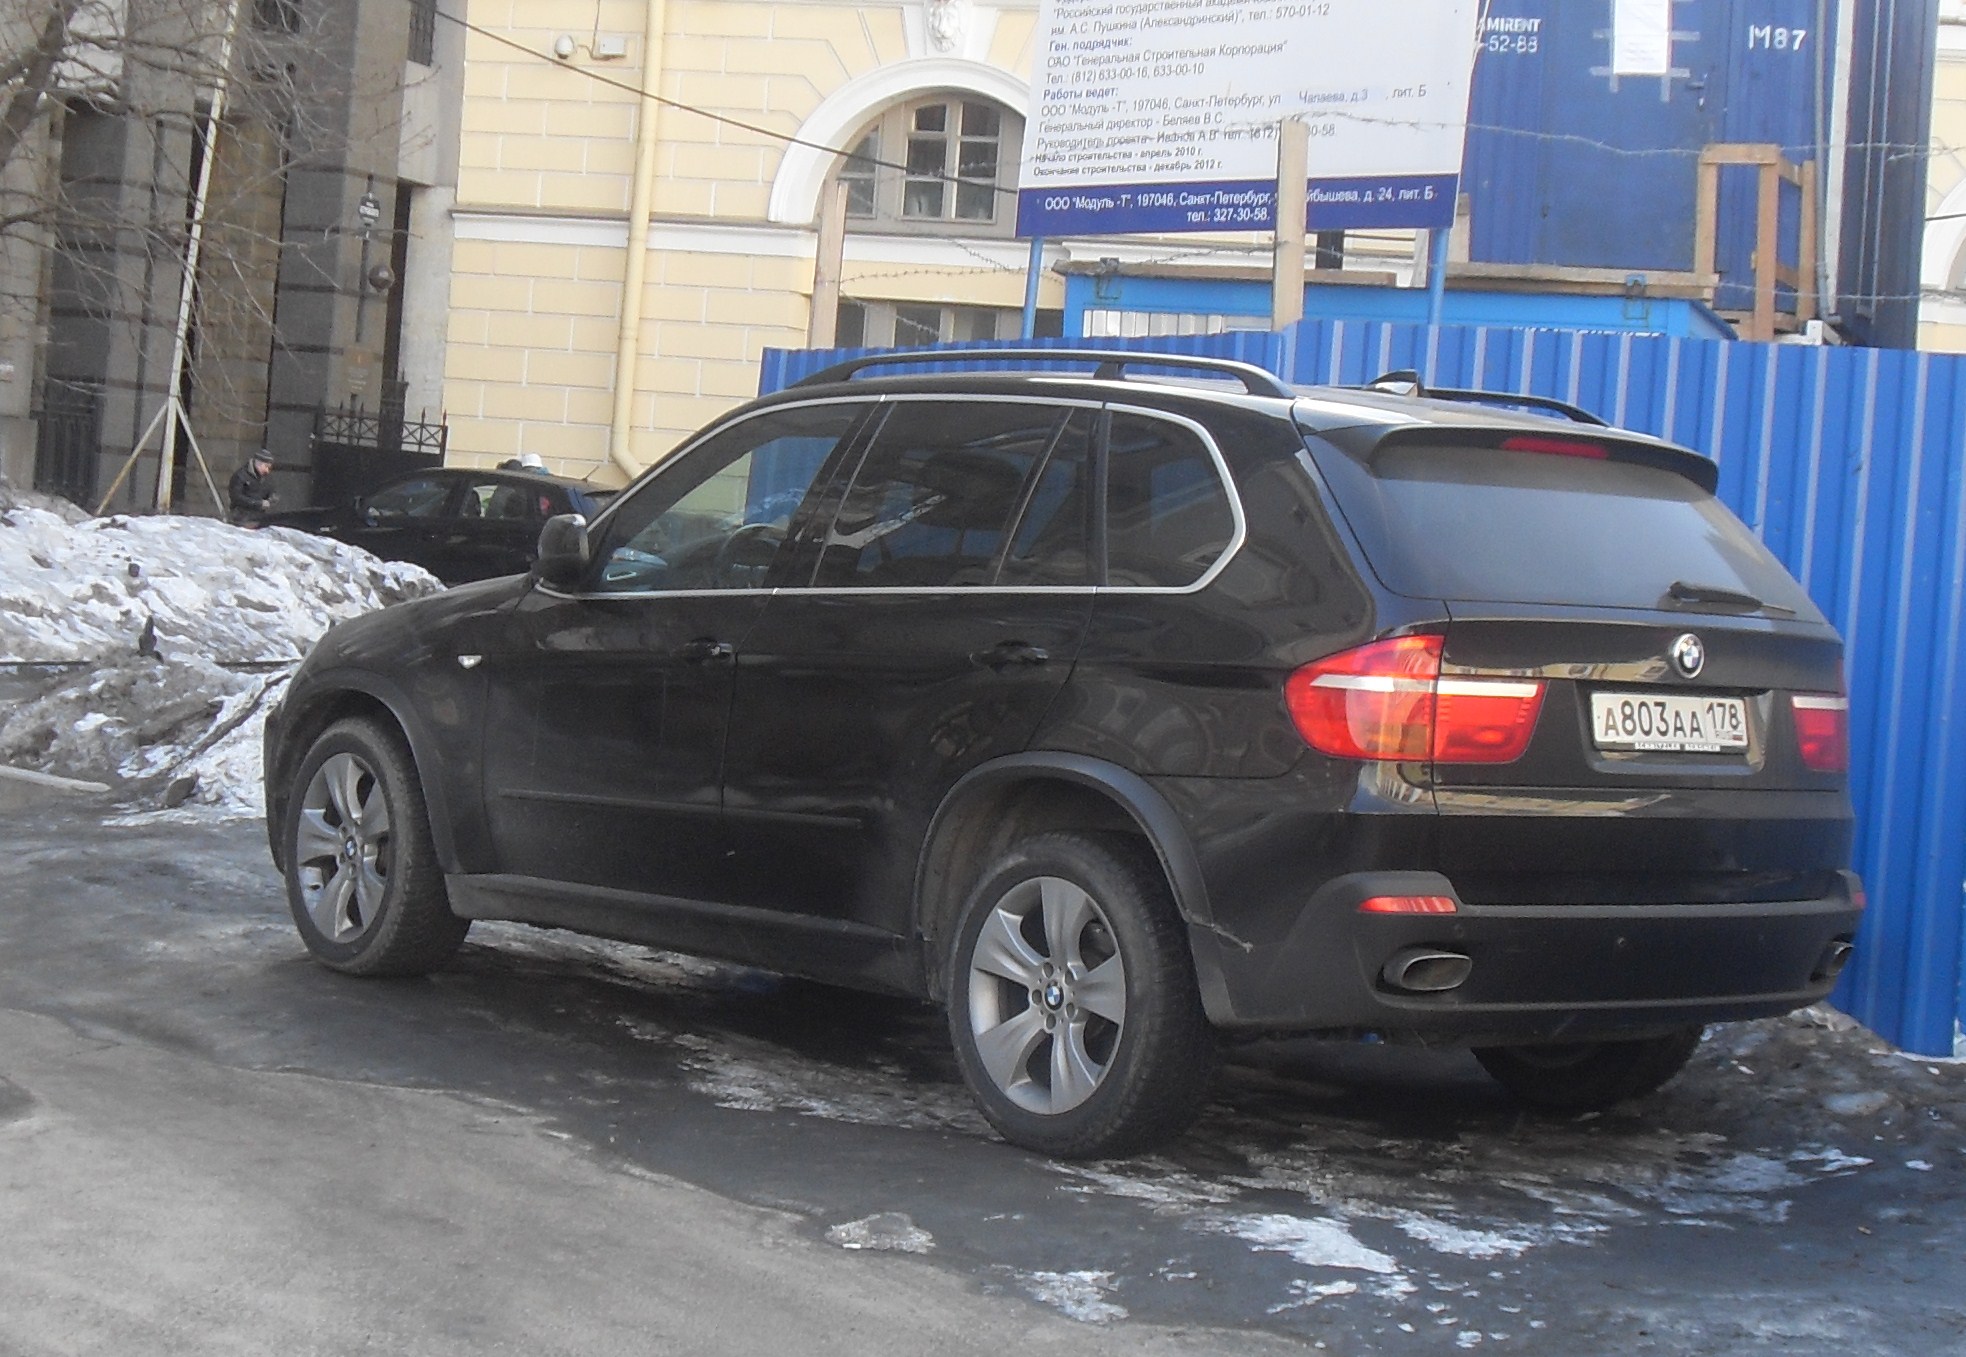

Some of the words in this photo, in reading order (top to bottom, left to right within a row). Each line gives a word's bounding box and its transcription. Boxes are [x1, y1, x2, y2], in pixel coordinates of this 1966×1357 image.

[1276, 3, 1331, 20] 570-01-12
[1049, 40, 1070, 52] Ген.
[1748, 24, 1807, 51] M87
[1047, 55, 1071, 68] ОАО
[1143, 47, 1217, 64] Строительная
[1219, 40, 1288, 59] Корпорация"
[1071, 69, 1097, 85] (812)
[1153, 62, 1205, 78] 633-00-10
[1043, 89, 1083, 101] Работы
[1085, 87, 1120, 101] ведет:
[1041, 104, 1067, 117] ООО
[1039, 119, 1104, 134] Генеральный
[1106, 117, 1154, 132] директор
[1068, 149, 1133, 164] строительства
[1174, 146, 1196, 157] 2010
[1081, 163, 1147, 177] строительства
[1194, 160, 1216, 171] 2012
[1045, 196, 1071, 210] ООО
[1137, 192, 1177, 207] 197046,
[1706, 701, 1742, 730] 178
